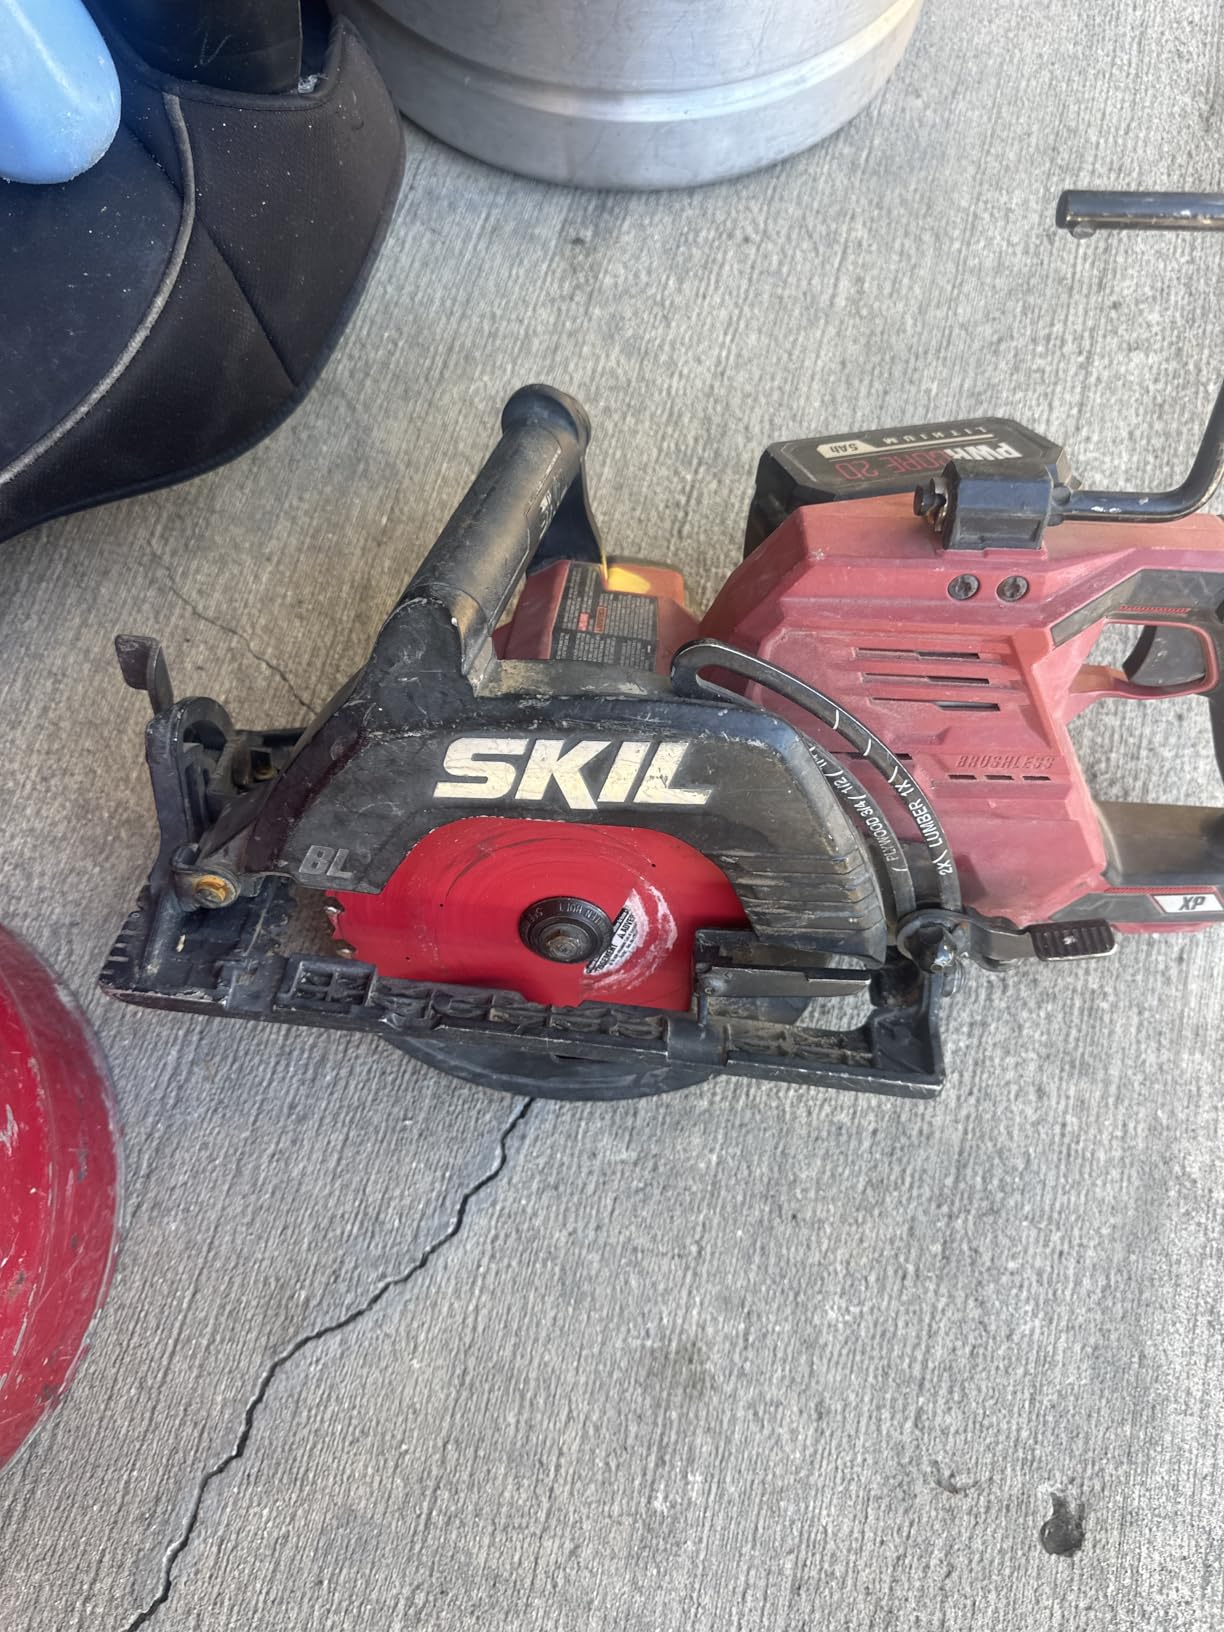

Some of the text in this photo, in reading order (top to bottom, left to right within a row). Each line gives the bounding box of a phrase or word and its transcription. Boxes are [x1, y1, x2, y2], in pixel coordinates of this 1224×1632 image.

[882, 426, 988, 444] LITHIUM
[835, 460, 880, 481] 20
[957, 754, 1056, 770] BRUSHLESS
[432, 736, 714, 811] SKIL
[833, 778, 853, 794] 1/2
[853, 800, 874, 817] 3/4
[894, 779, 954, 876] 2X LUMBER 1X
[865, 816, 900, 862] PLYWOOD
[298, 843, 356, 880] BL
[1178, 895, 1206, 912] XP
